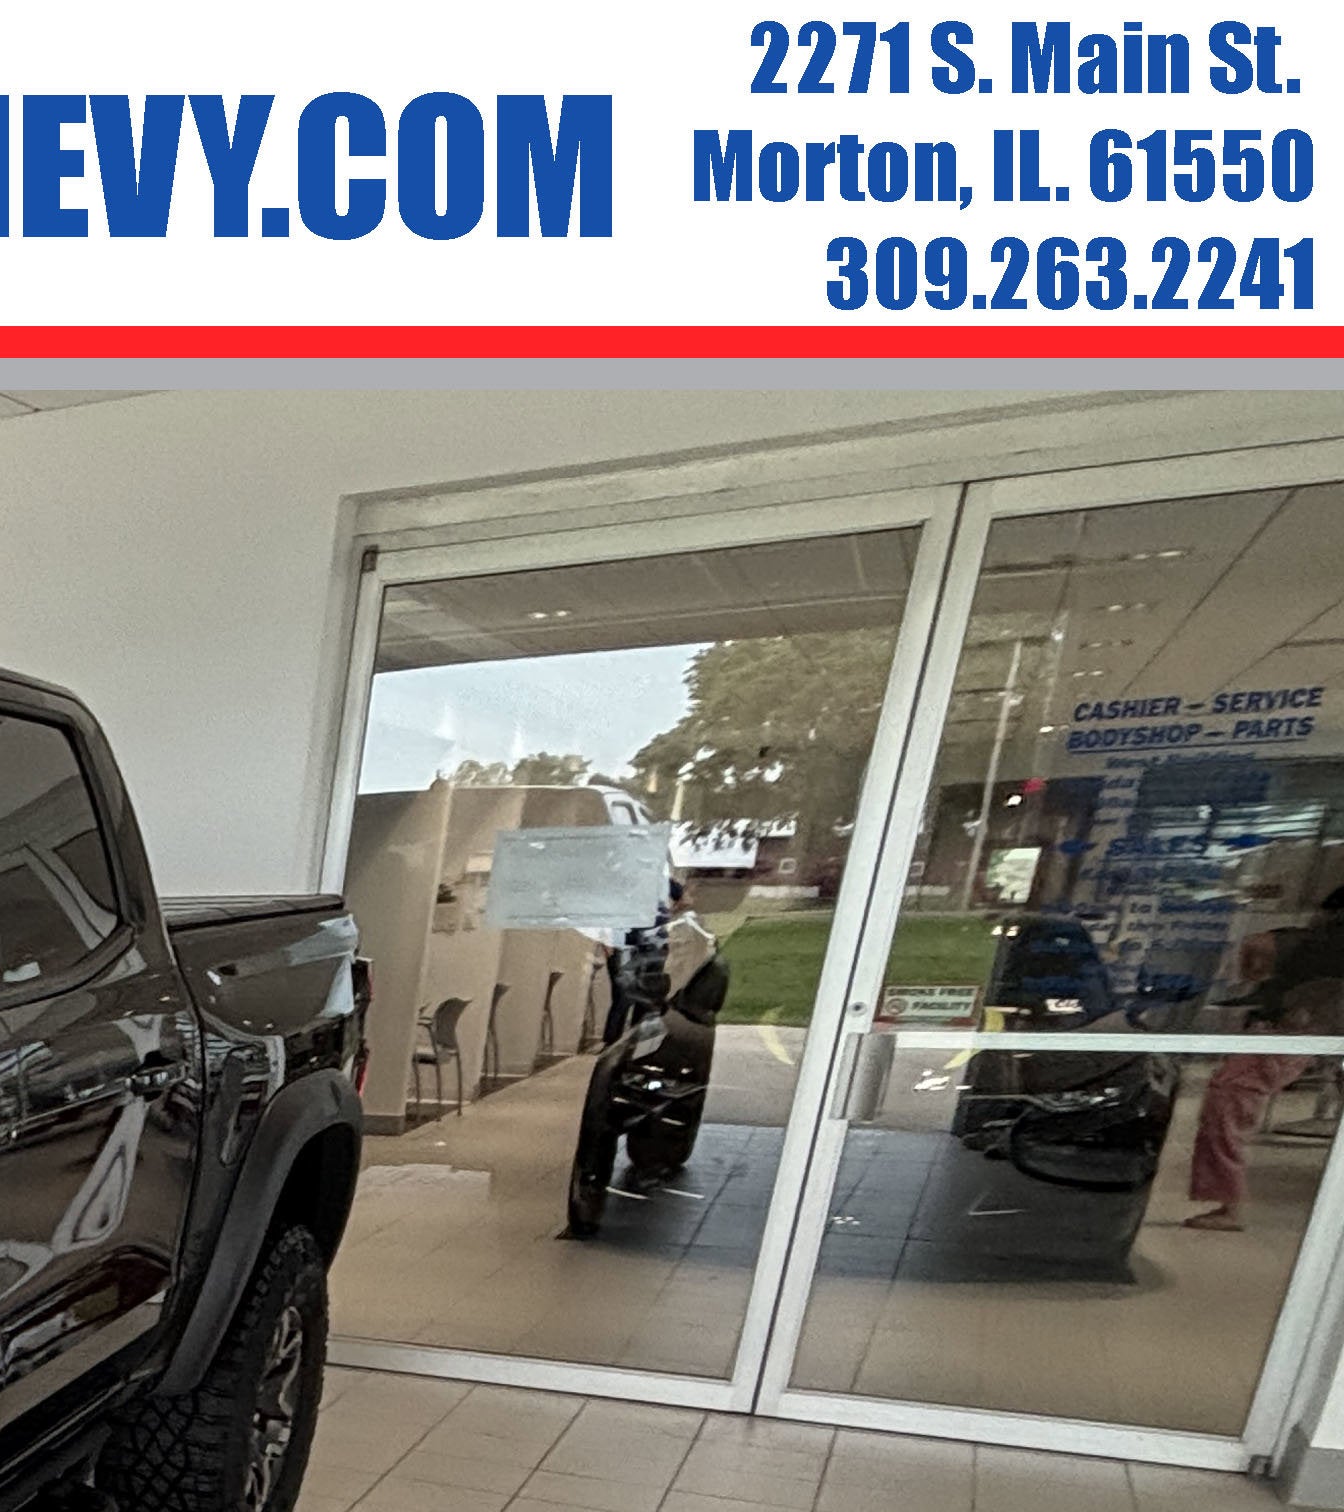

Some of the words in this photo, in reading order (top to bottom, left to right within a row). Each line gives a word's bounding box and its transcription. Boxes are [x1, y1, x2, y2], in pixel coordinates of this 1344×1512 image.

[1073, 696, 1183, 722] CASHIER
[1211, 686, 1327, 714] SERVICE
[1067, 723, 1203, 750] BODYSHOP
[1232, 716, 1316, 739] PARTS
